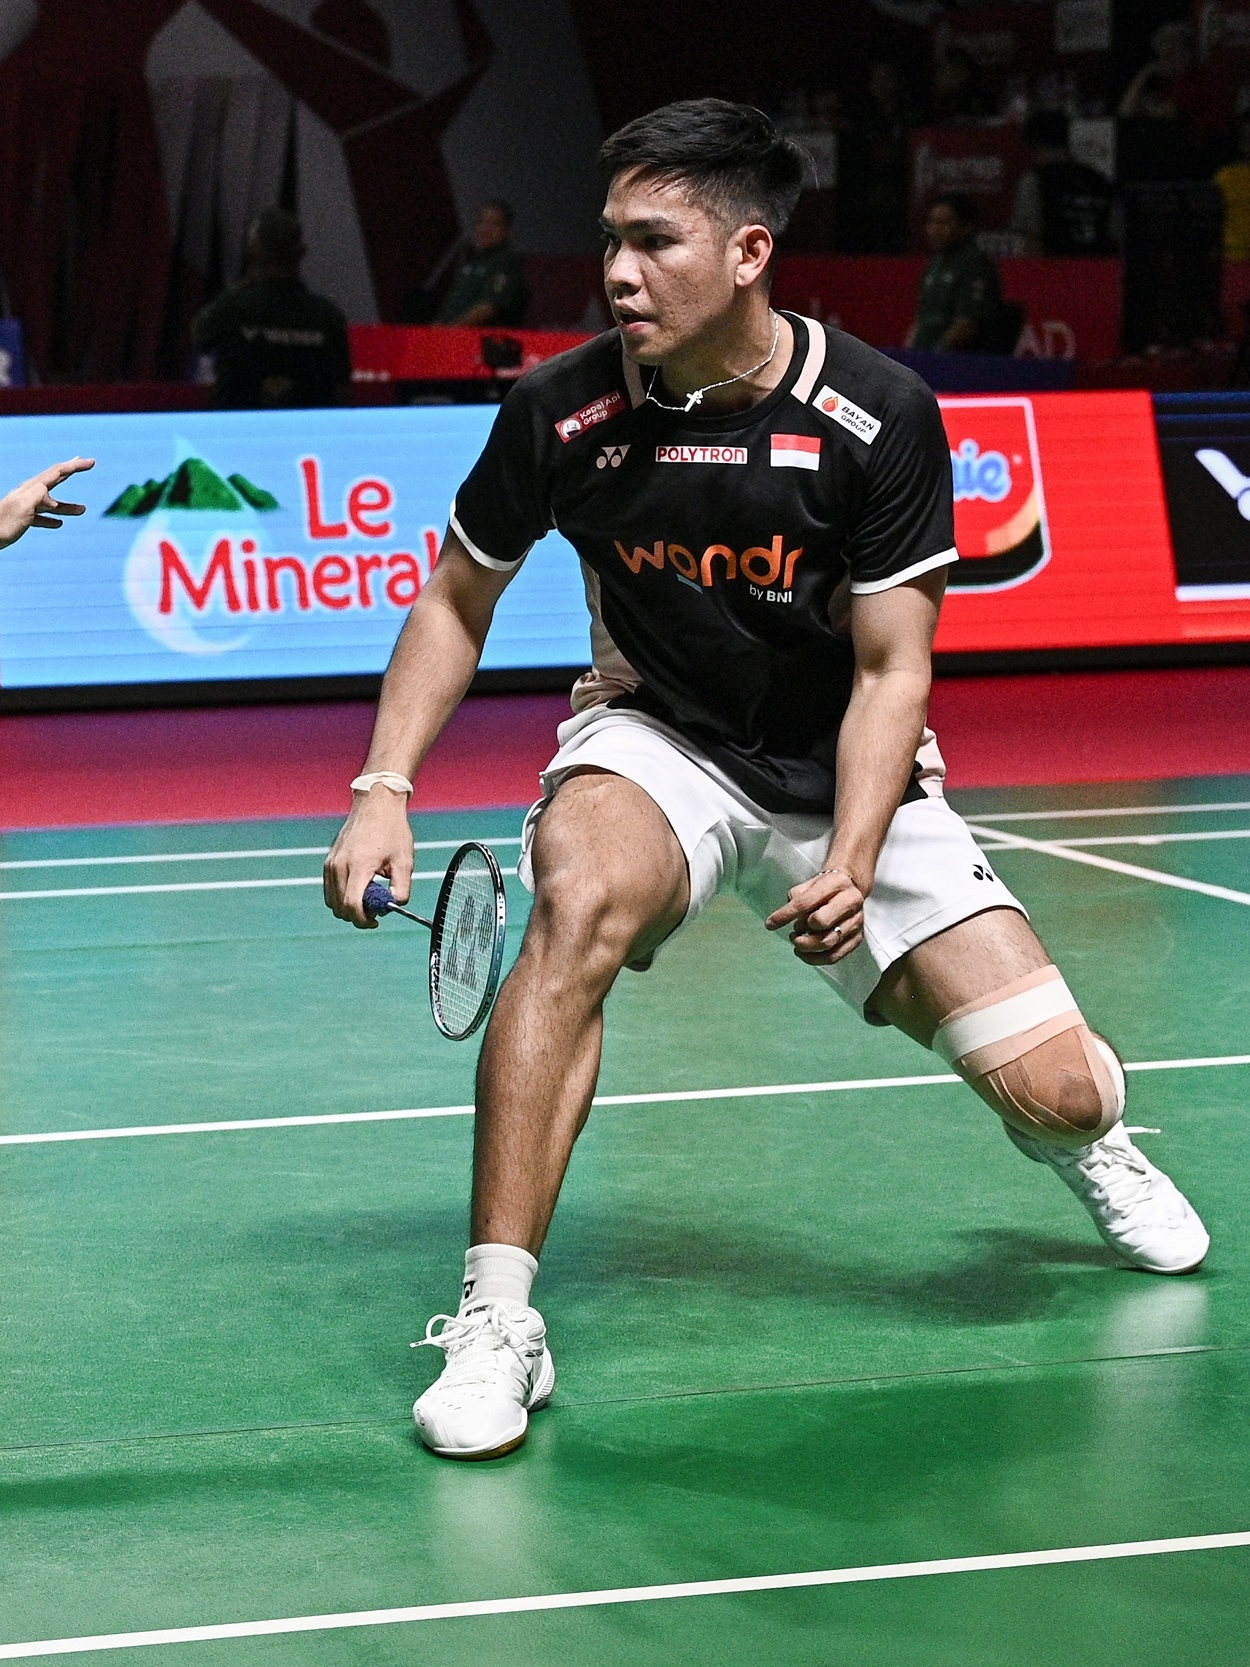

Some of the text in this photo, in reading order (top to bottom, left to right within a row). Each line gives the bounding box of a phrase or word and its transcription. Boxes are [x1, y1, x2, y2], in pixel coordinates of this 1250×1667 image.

[579, 401, 605, 420] Kapal
[583, 410, 608, 425] Group
[841, 406, 875, 431] BAYAN
[840, 415, 867, 433] GROUP
[657, 447, 745, 463] POLYTRON
[301, 457, 393, 539] Le
[613, 535, 803, 589] wondr
[750, 584, 793, 603] by BNI
